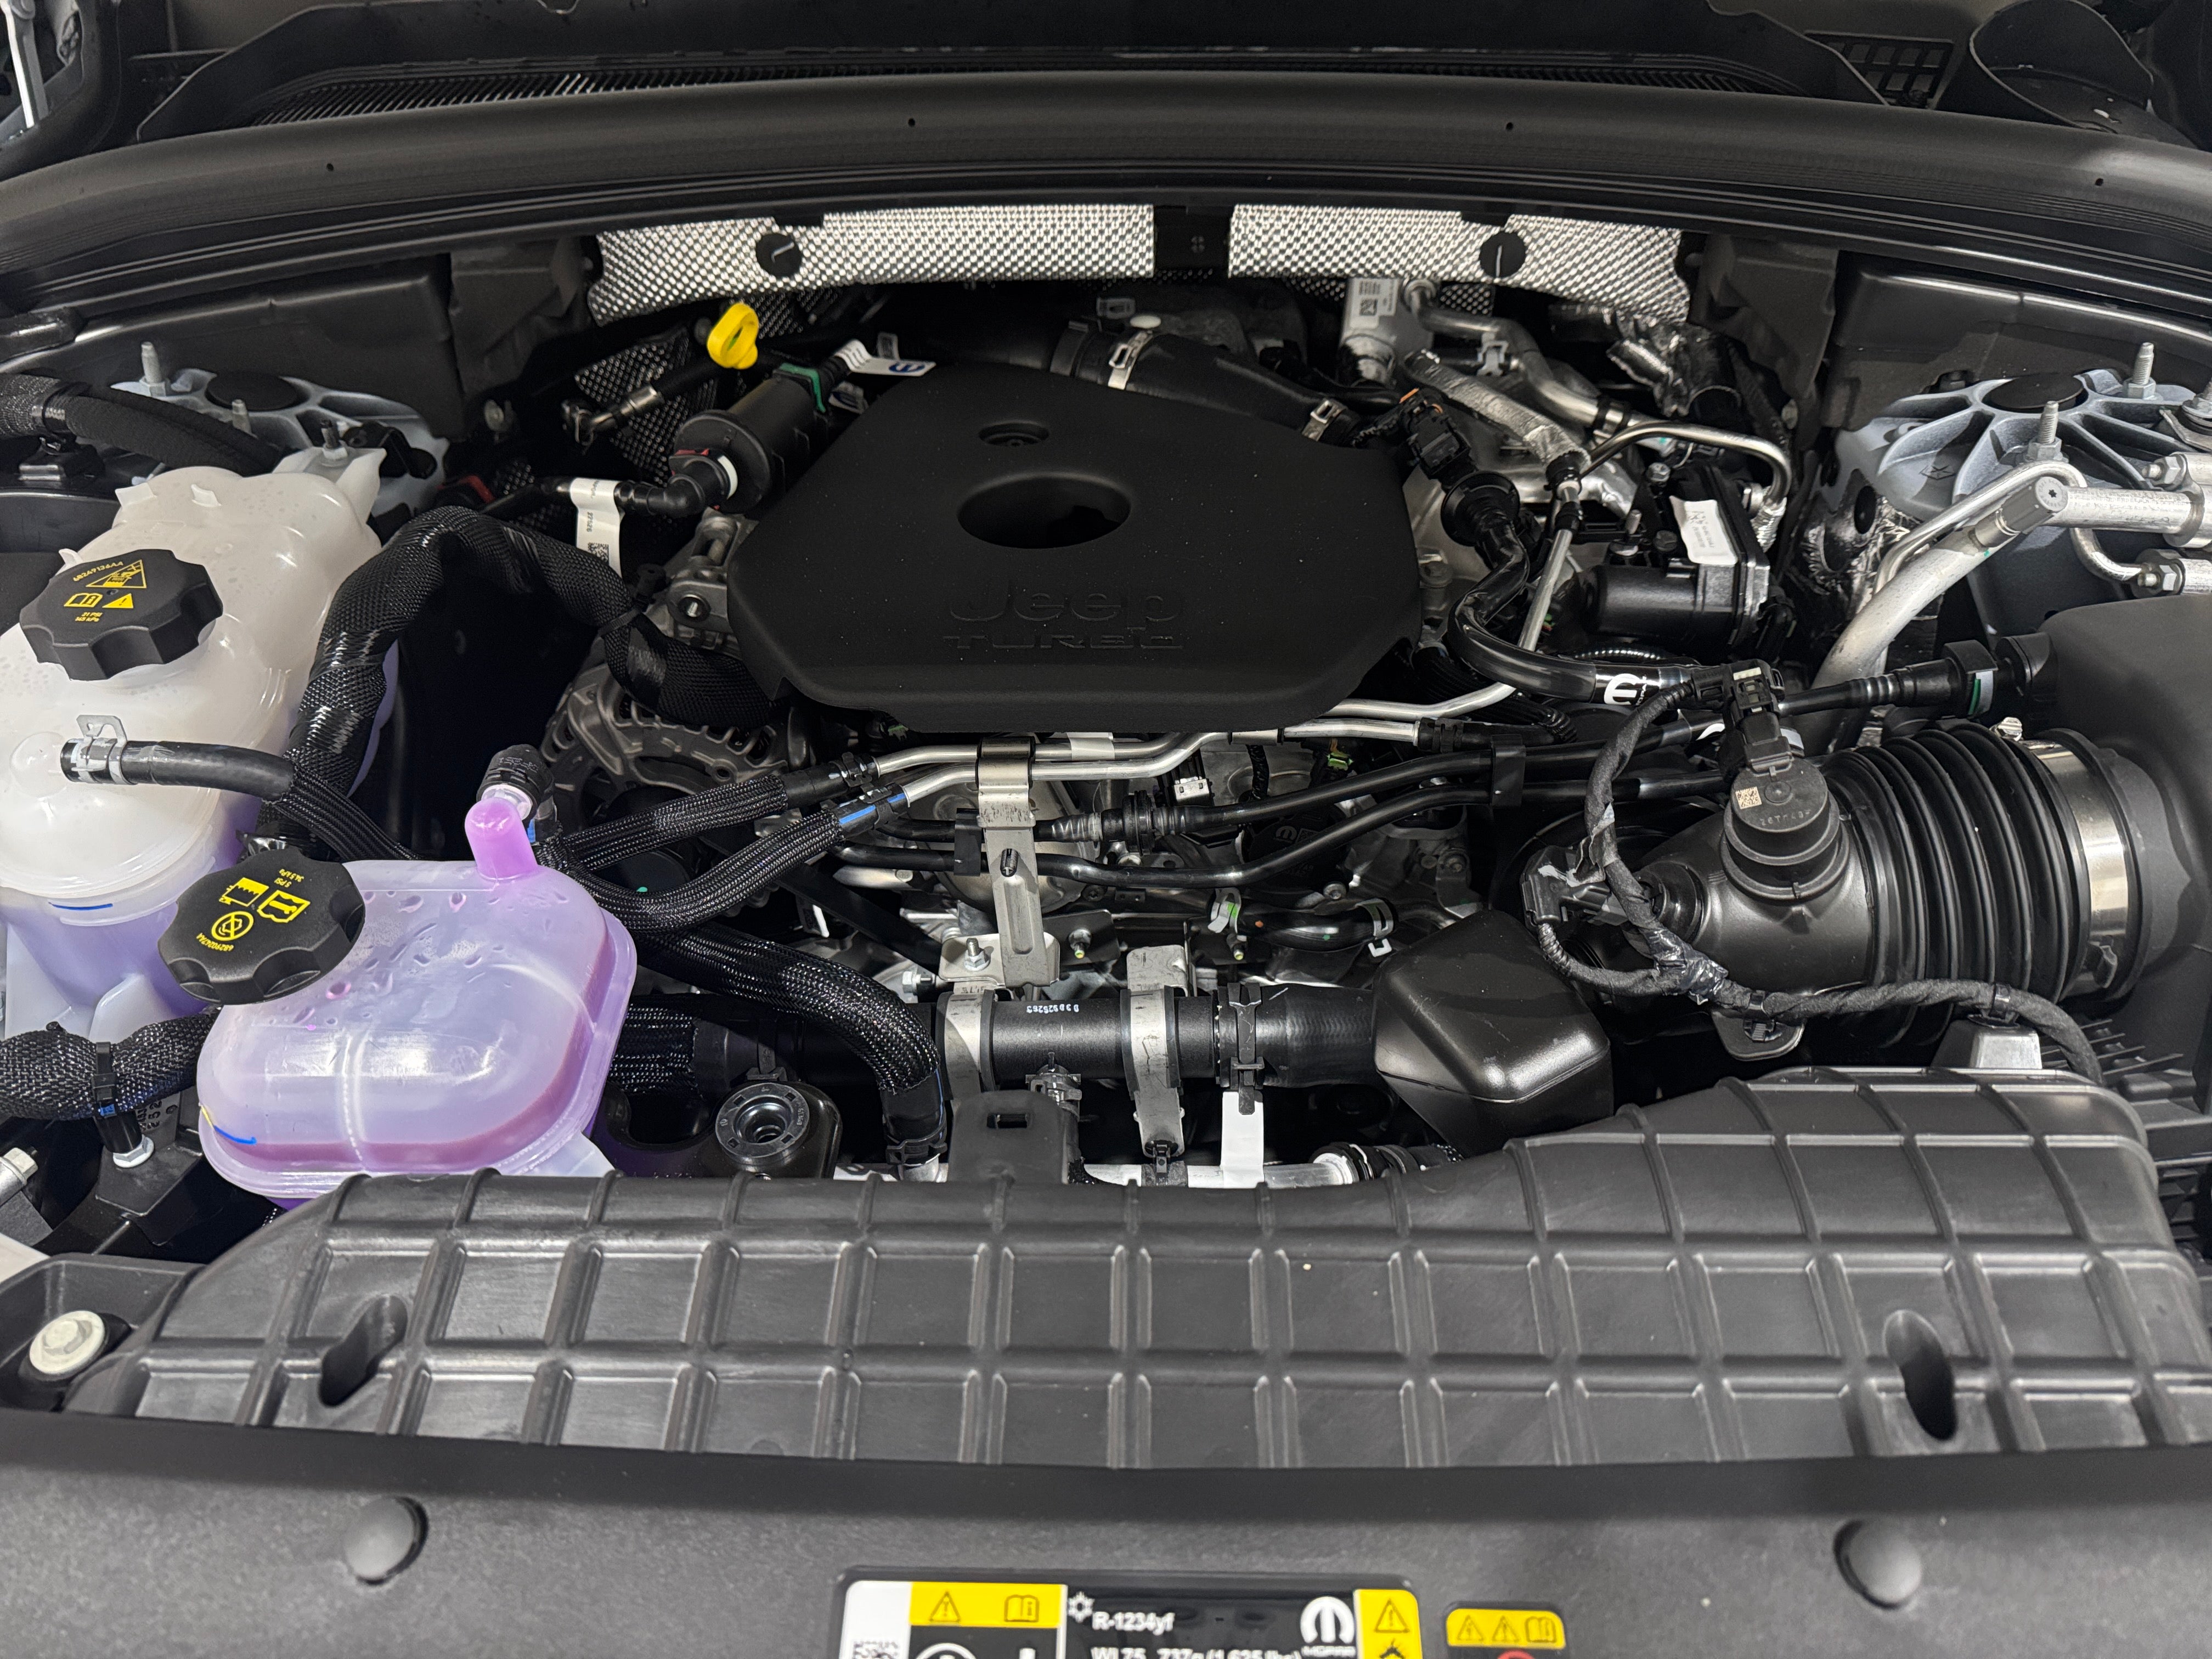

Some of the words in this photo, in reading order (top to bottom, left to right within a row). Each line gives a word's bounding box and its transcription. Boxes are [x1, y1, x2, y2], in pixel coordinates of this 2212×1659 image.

[949, 579, 1184, 630] Jeep
[942, 635, 1184, 649] TURBO
[274, 877, 287, 886] PSI
[1091, 1612, 1175, 1636] R-1234yf
